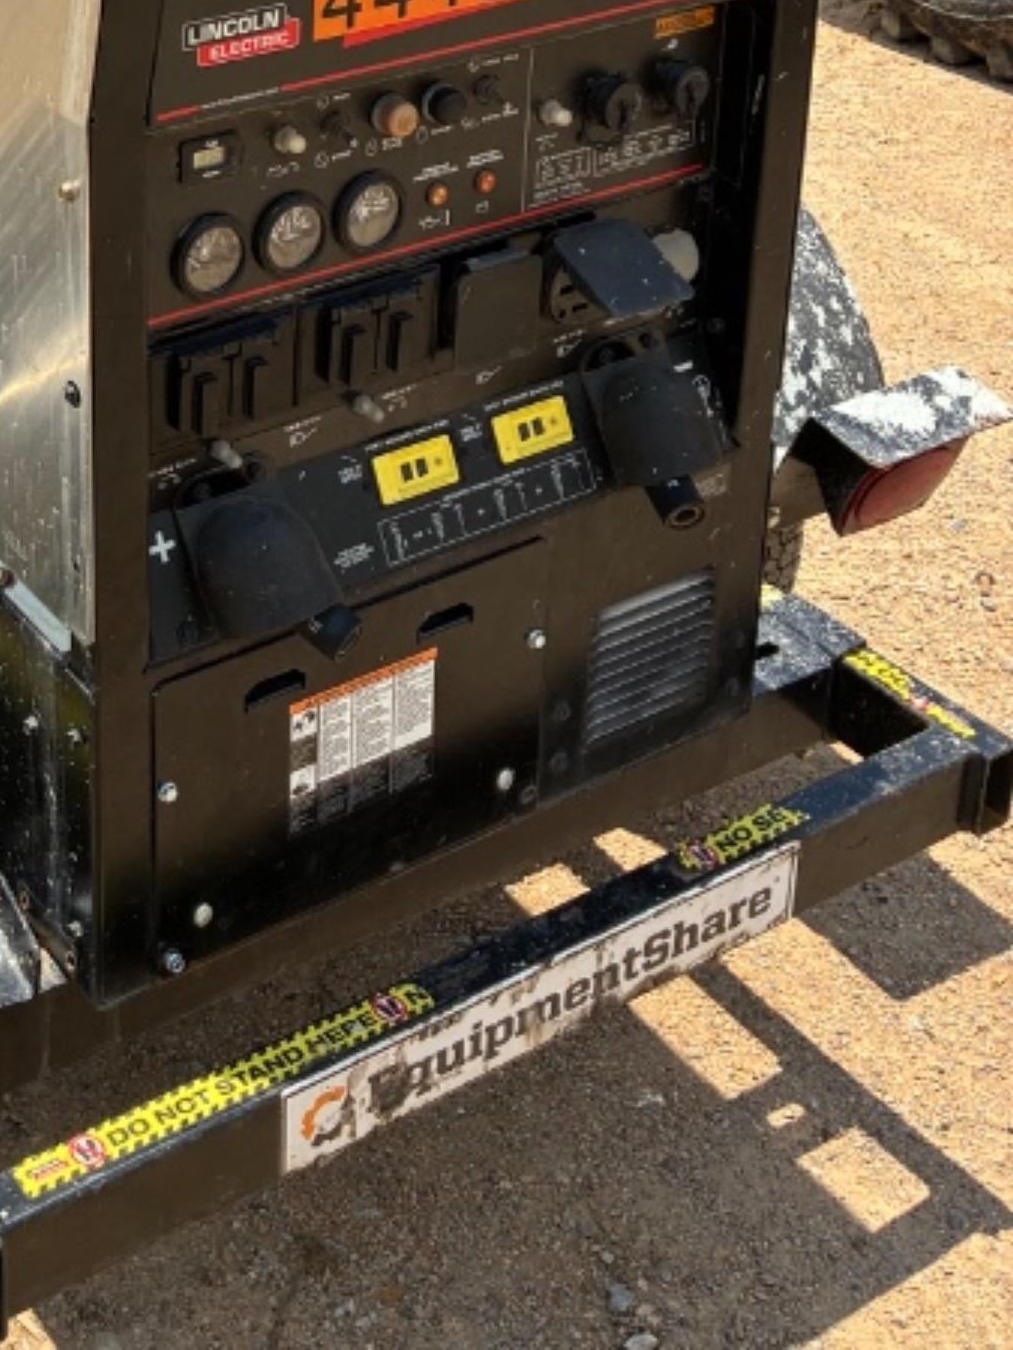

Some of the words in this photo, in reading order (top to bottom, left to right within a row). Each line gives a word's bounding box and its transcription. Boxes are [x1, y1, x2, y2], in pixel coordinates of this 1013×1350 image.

[188, 8, 280, 45] LINCOLN
[209, 32, 290, 61] ELECTRIC
[715, 827, 753, 851] NO
[367, 887, 772, 1118] EquipmentShare
[106, 1117, 150, 1147] DO
[153, 1088, 210, 1125] NOT
[214, 1046, 304, 1096] STAND
